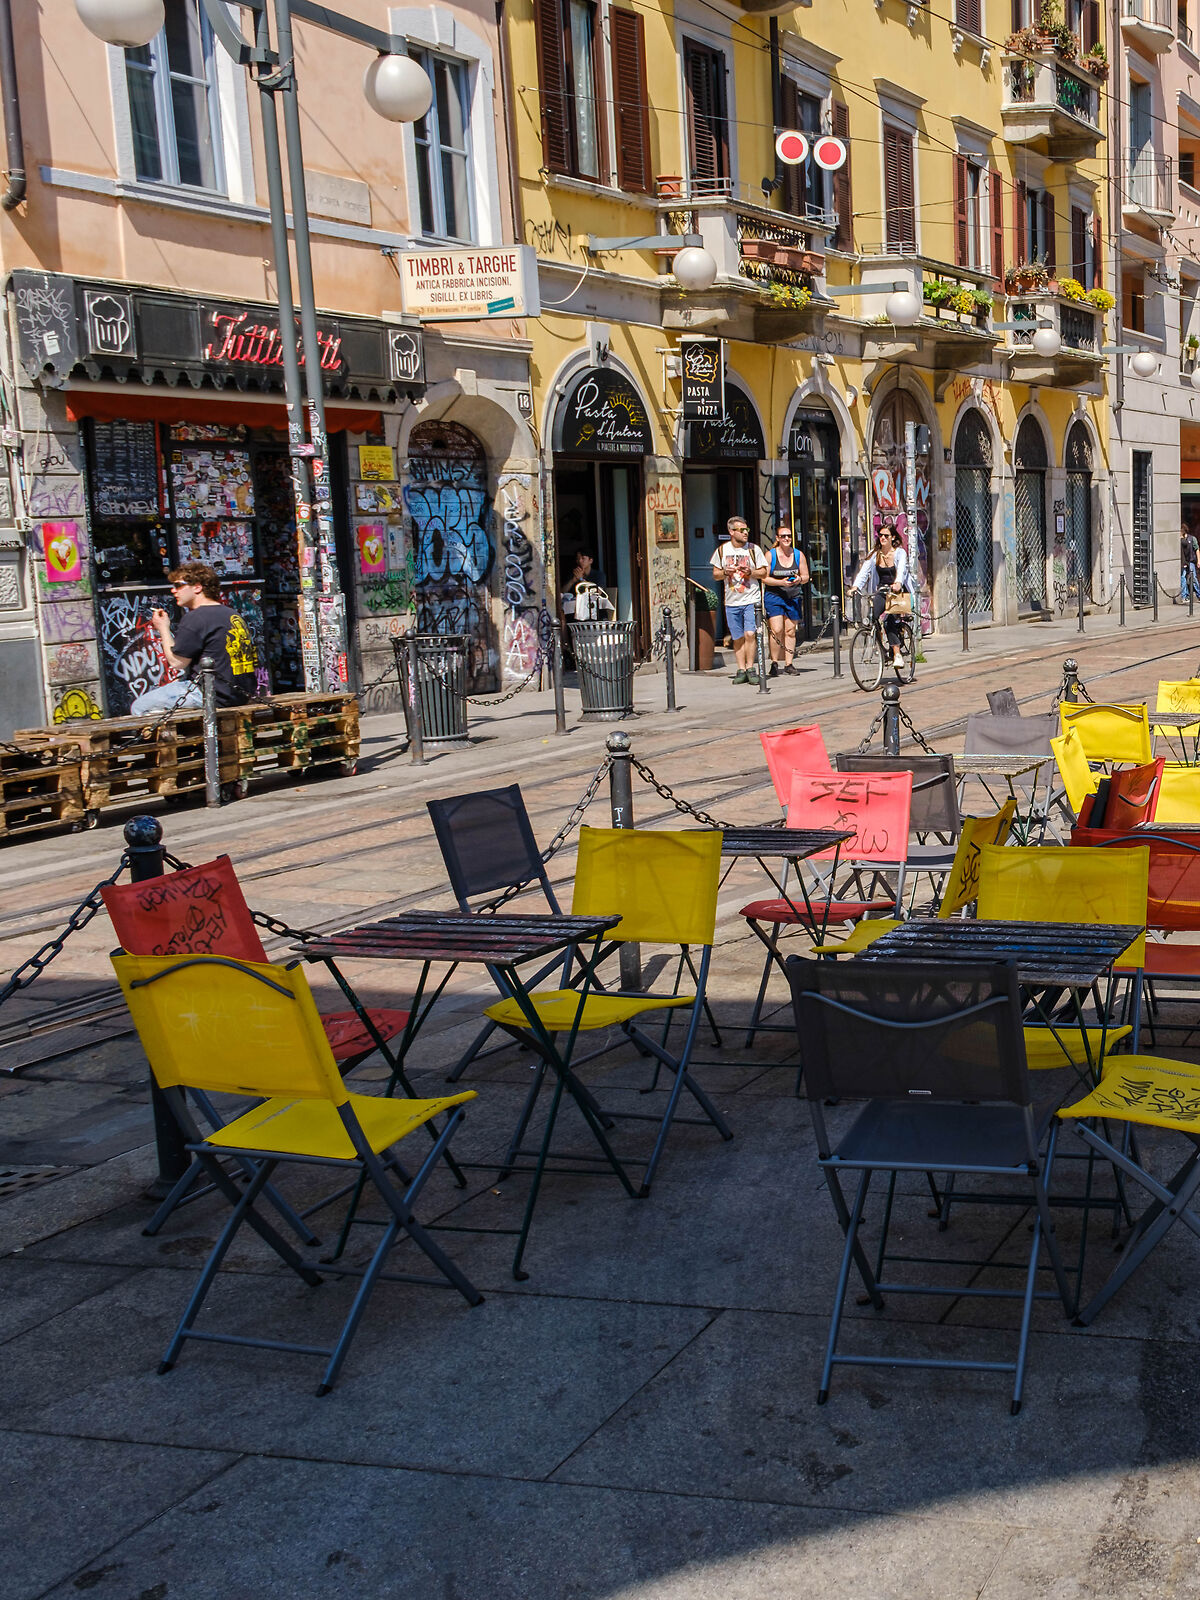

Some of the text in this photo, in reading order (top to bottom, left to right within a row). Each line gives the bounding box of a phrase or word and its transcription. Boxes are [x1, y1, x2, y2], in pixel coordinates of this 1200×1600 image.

[408, 255, 516, 277] TIMBRI & TARGHE
[416, 277, 512, 290] ANTICA FABBRICA INCISIONI,
[430, 292, 456, 302] SIGILLI,
[459, 291, 468, 300] EX
[575, 378, 617, 419] Pasta
[688, 387, 710, 397] PASTA
[519, 394, 530, 409] 18
[697, 406, 719, 416] PIZZA
[597, 420, 644, 440] d'Autore
[720, 429, 758, 447] d'Autore
[790, 428, 813, 452] Tom
